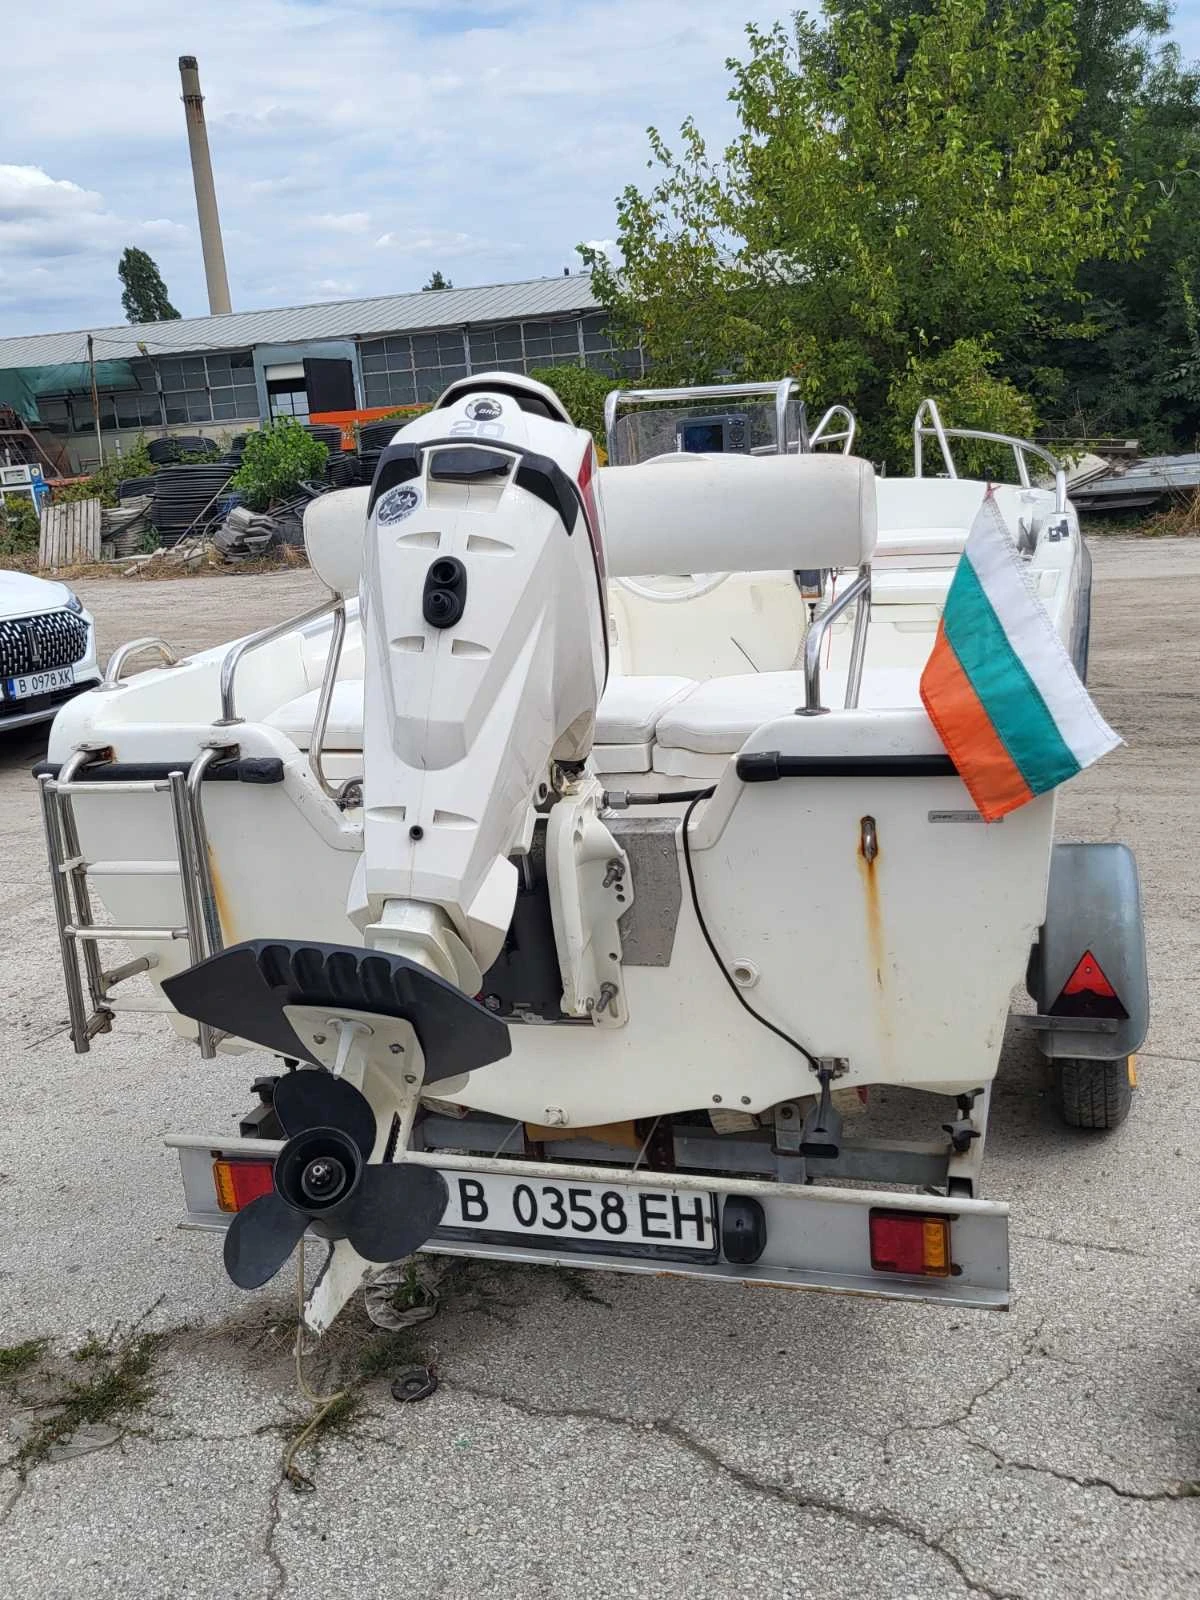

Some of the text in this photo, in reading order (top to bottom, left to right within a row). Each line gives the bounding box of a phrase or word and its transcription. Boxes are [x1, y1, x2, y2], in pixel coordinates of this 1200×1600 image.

[449, 420, 506, 438] 20
[19, 669, 71, 693] B 0978 XK
[458, 1178, 705, 1242] B 0358 EH
